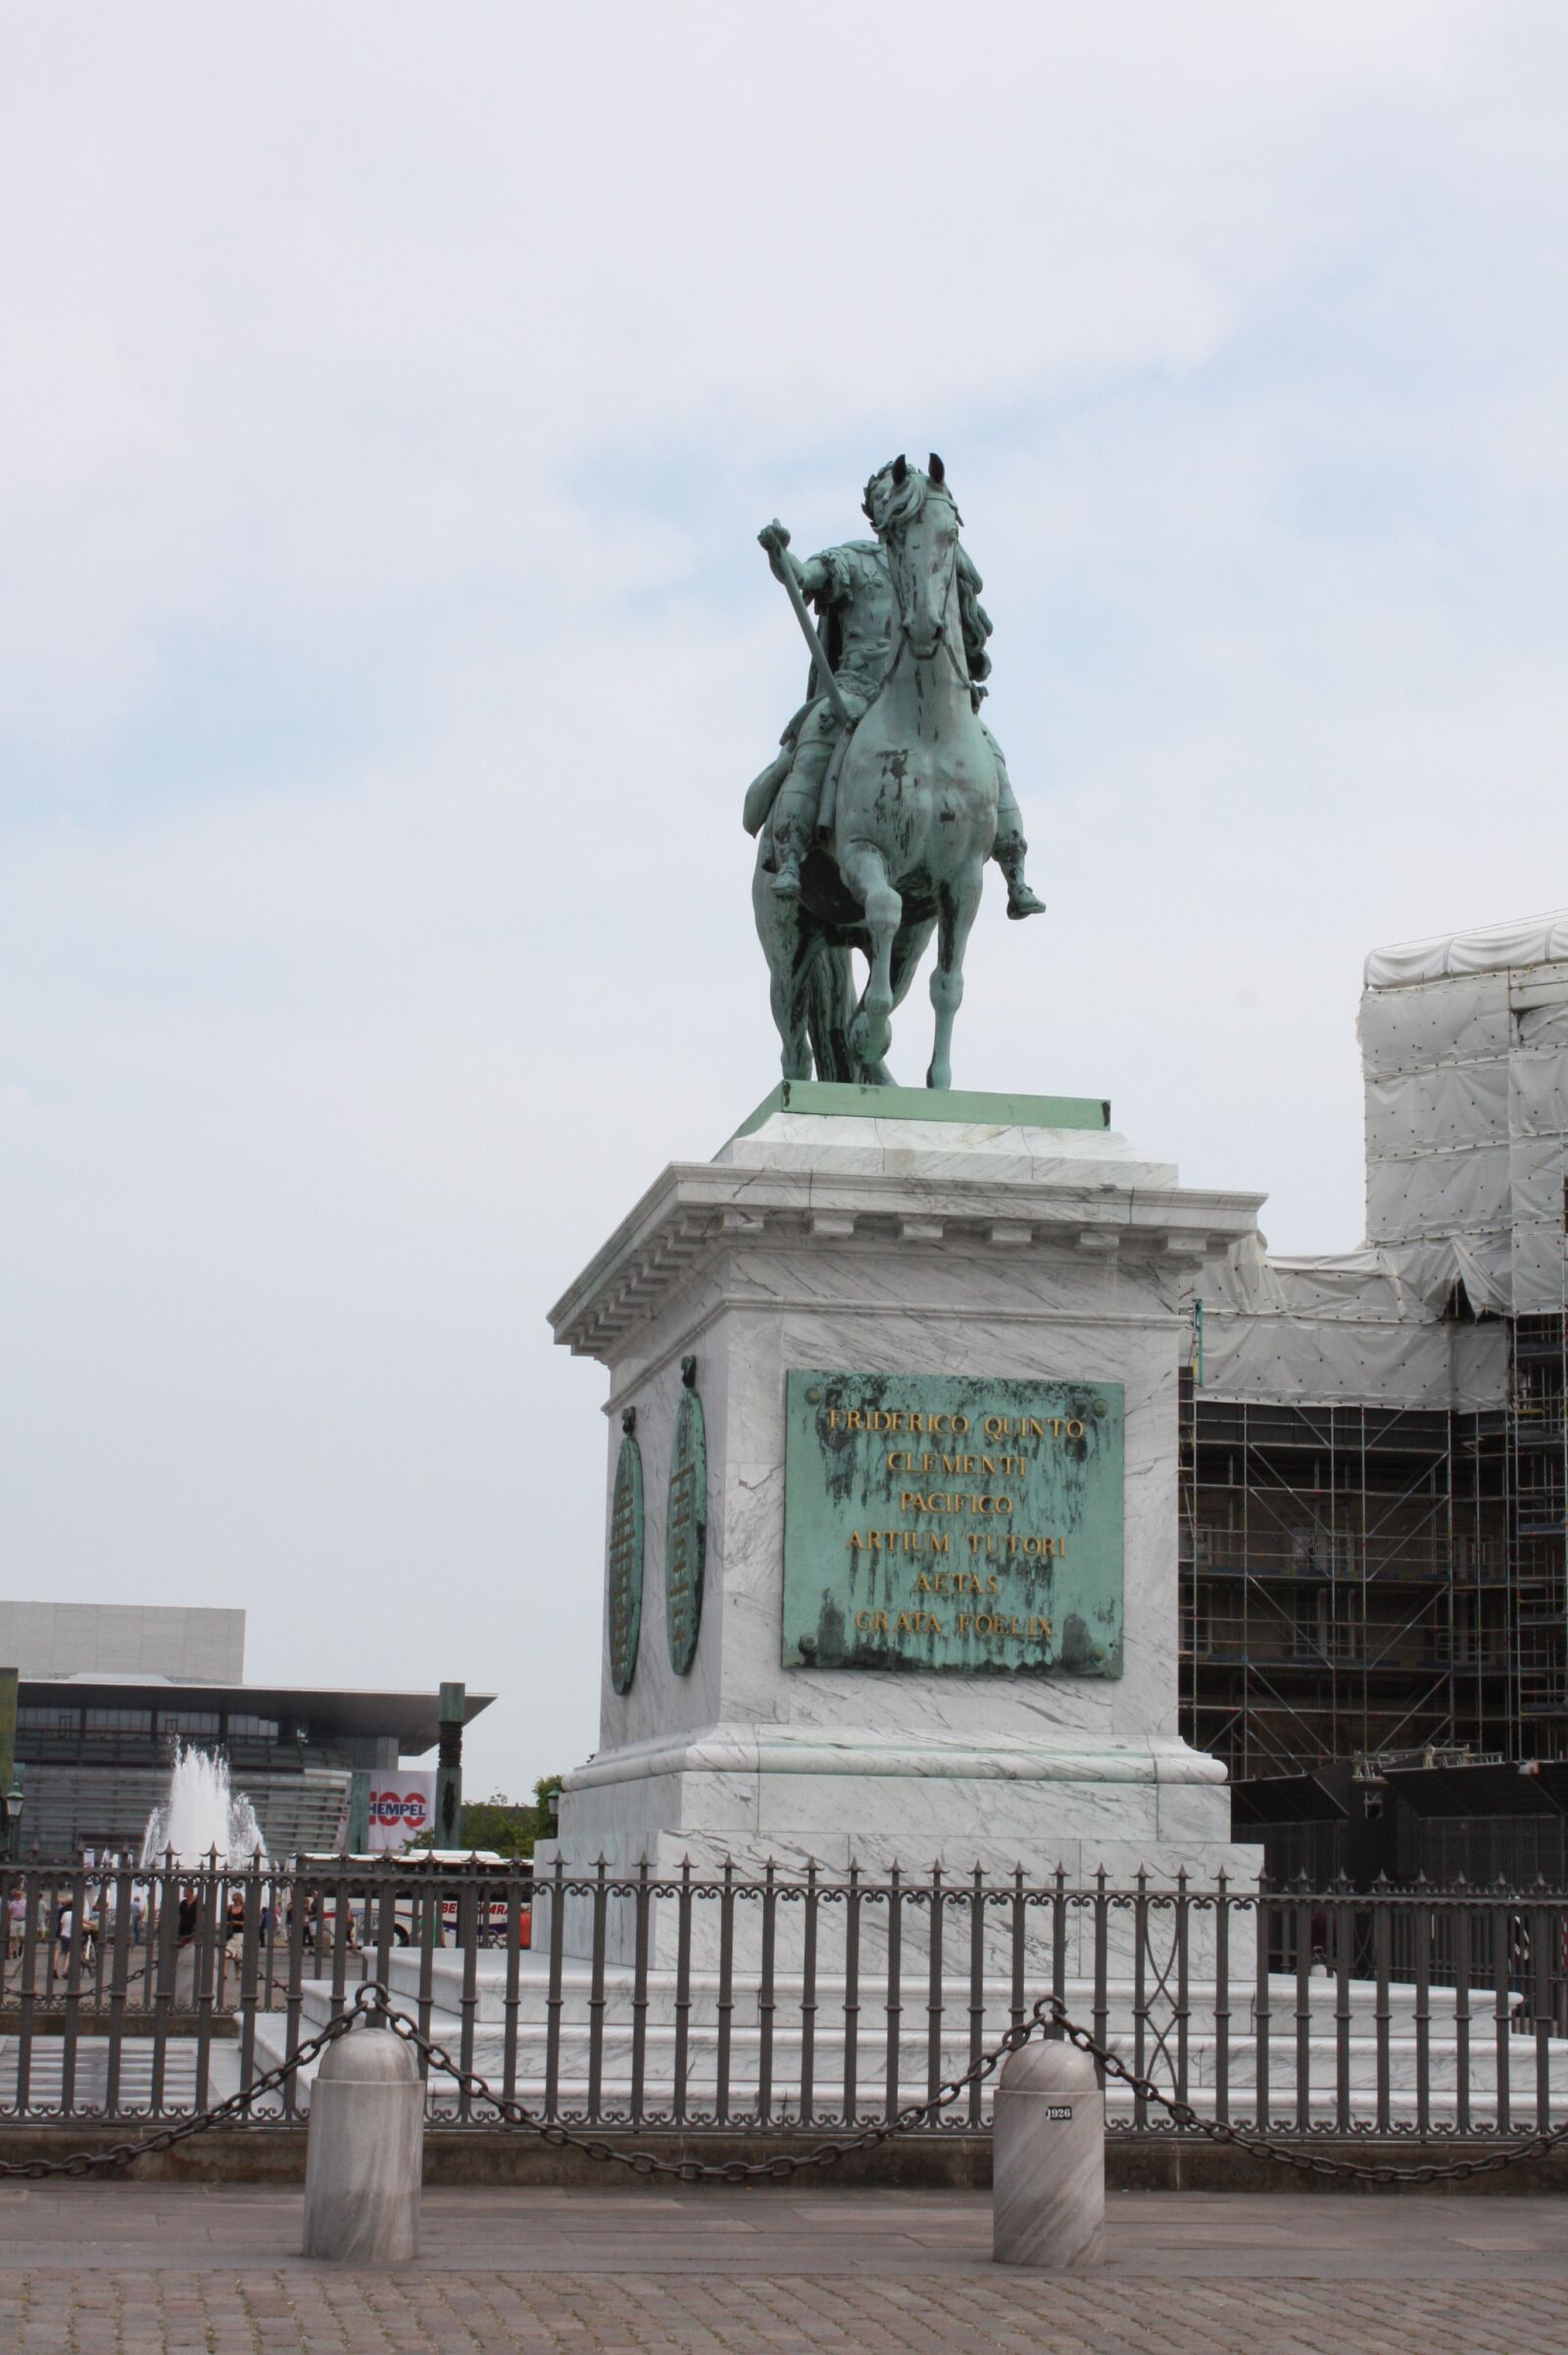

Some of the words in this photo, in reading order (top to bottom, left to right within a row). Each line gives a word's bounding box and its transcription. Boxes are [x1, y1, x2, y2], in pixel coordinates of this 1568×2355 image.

[829, 1409, 969, 1434] FRIDERICO
[984, 1416, 1085, 1440] QUINTO
[887, 1450, 1027, 1476] CLEMENTI
[900, 1491, 1013, 1514] PACIFICO
[846, 1530, 951, 1553] ARTIUM
[968, 1535, 1066, 1557] TUTORI
[914, 1572, 998, 1594] AETAS
[856, 1610, 942, 1633] GRATA
[368, 1803, 426, 1816] HEMPEL
